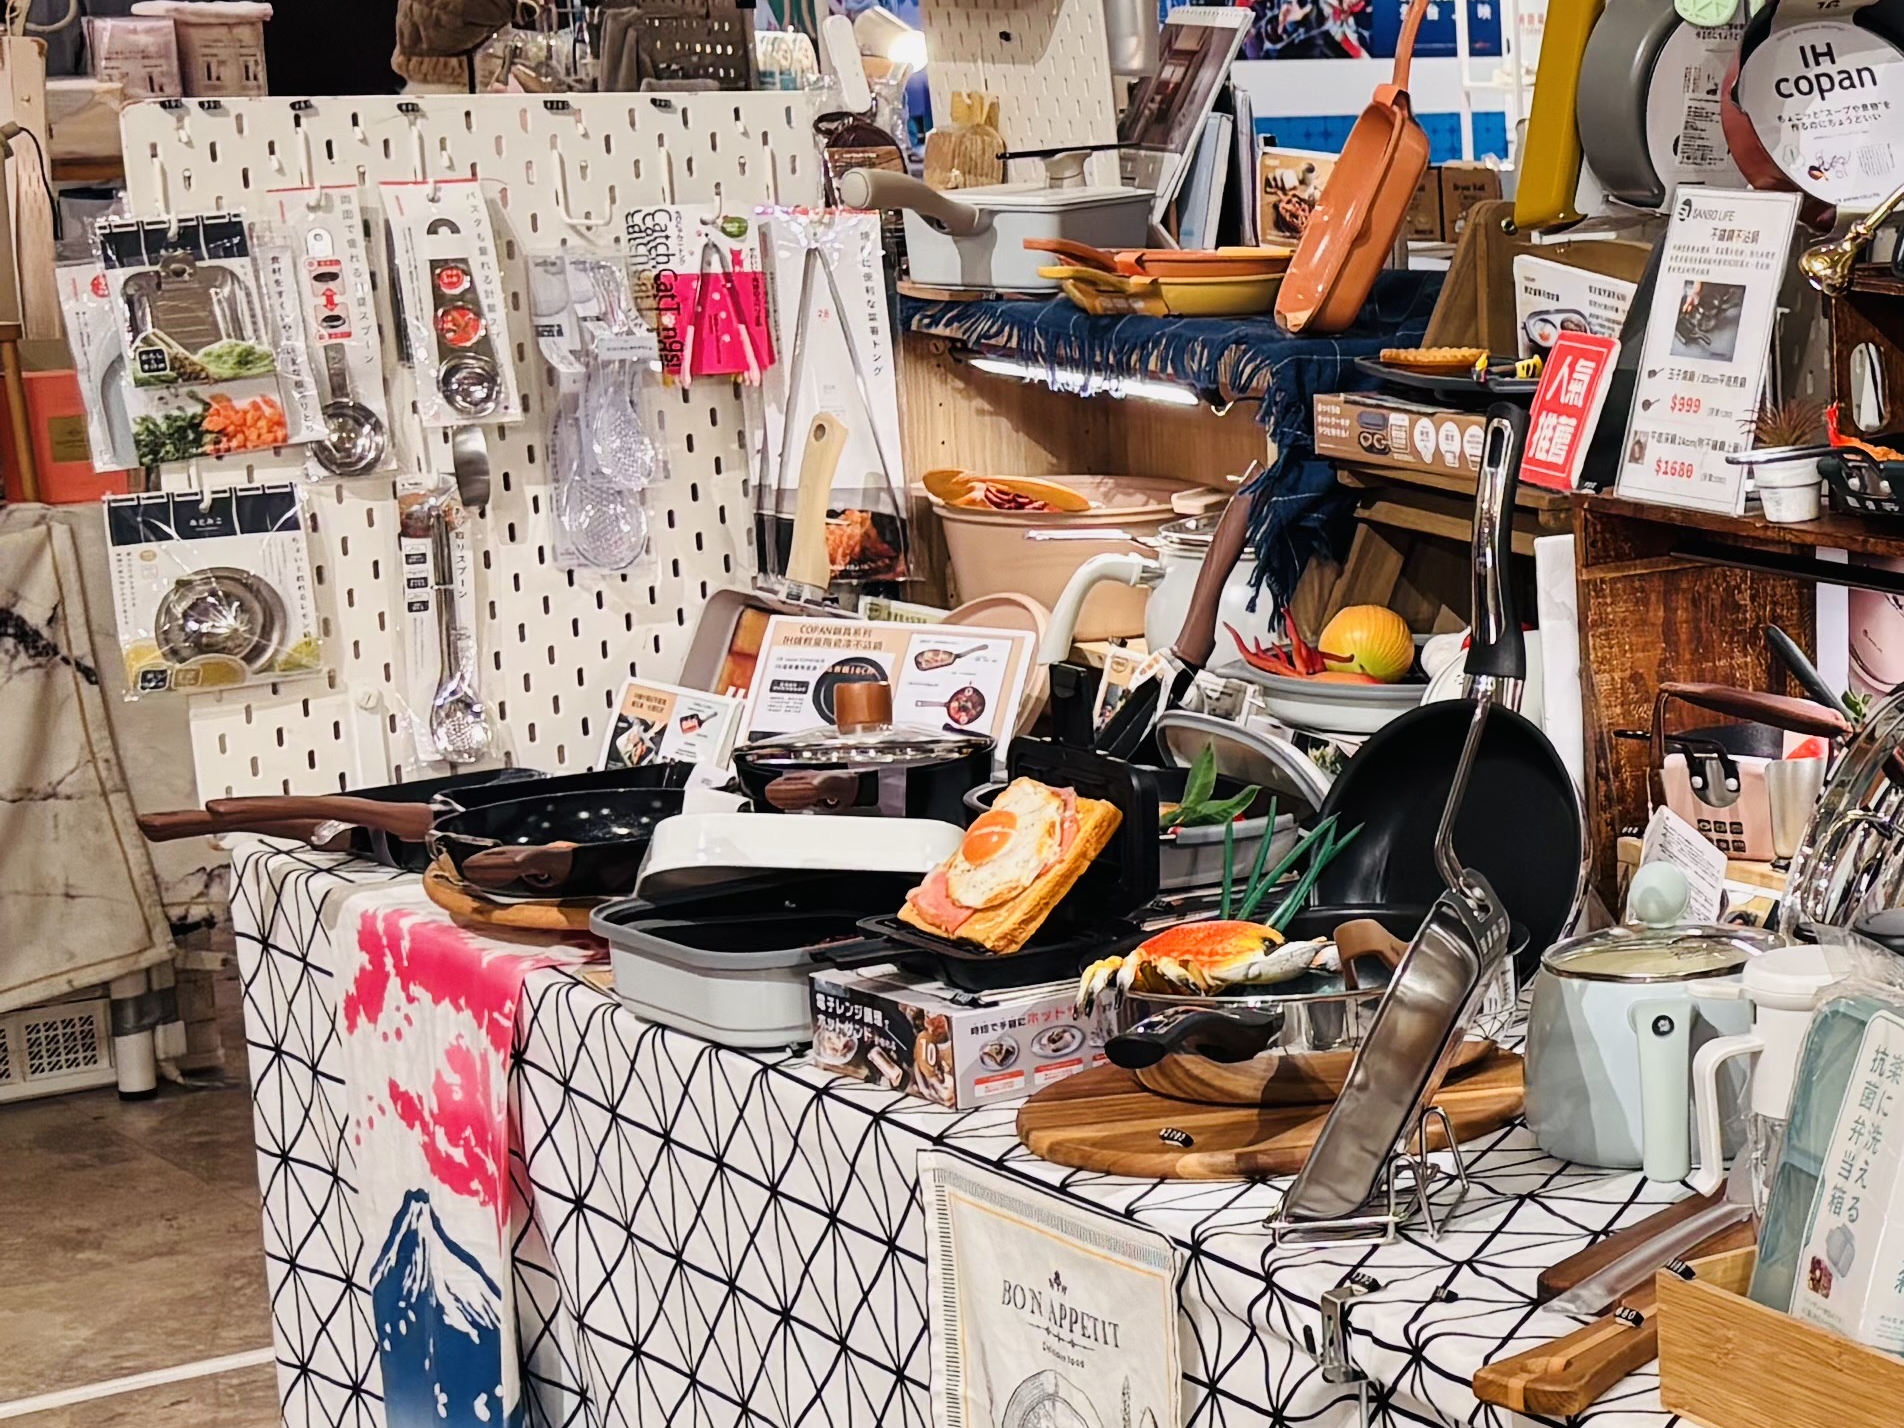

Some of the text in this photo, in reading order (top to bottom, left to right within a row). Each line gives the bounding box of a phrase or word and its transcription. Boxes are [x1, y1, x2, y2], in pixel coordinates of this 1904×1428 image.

[1798, 41, 1837, 70] IH
[1773, 65, 1878, 102] copan
[1545, 354, 1597, 409] 人氣
[1669, 393, 1702, 415] $999
[1526, 409, 1578, 466] 推薦
[1653, 456, 1695, 480] $1680
[1827, 1044, 1891, 1218] 抗菌弁当箱
[1001, 1278, 1120, 1349] BON APPETIT
